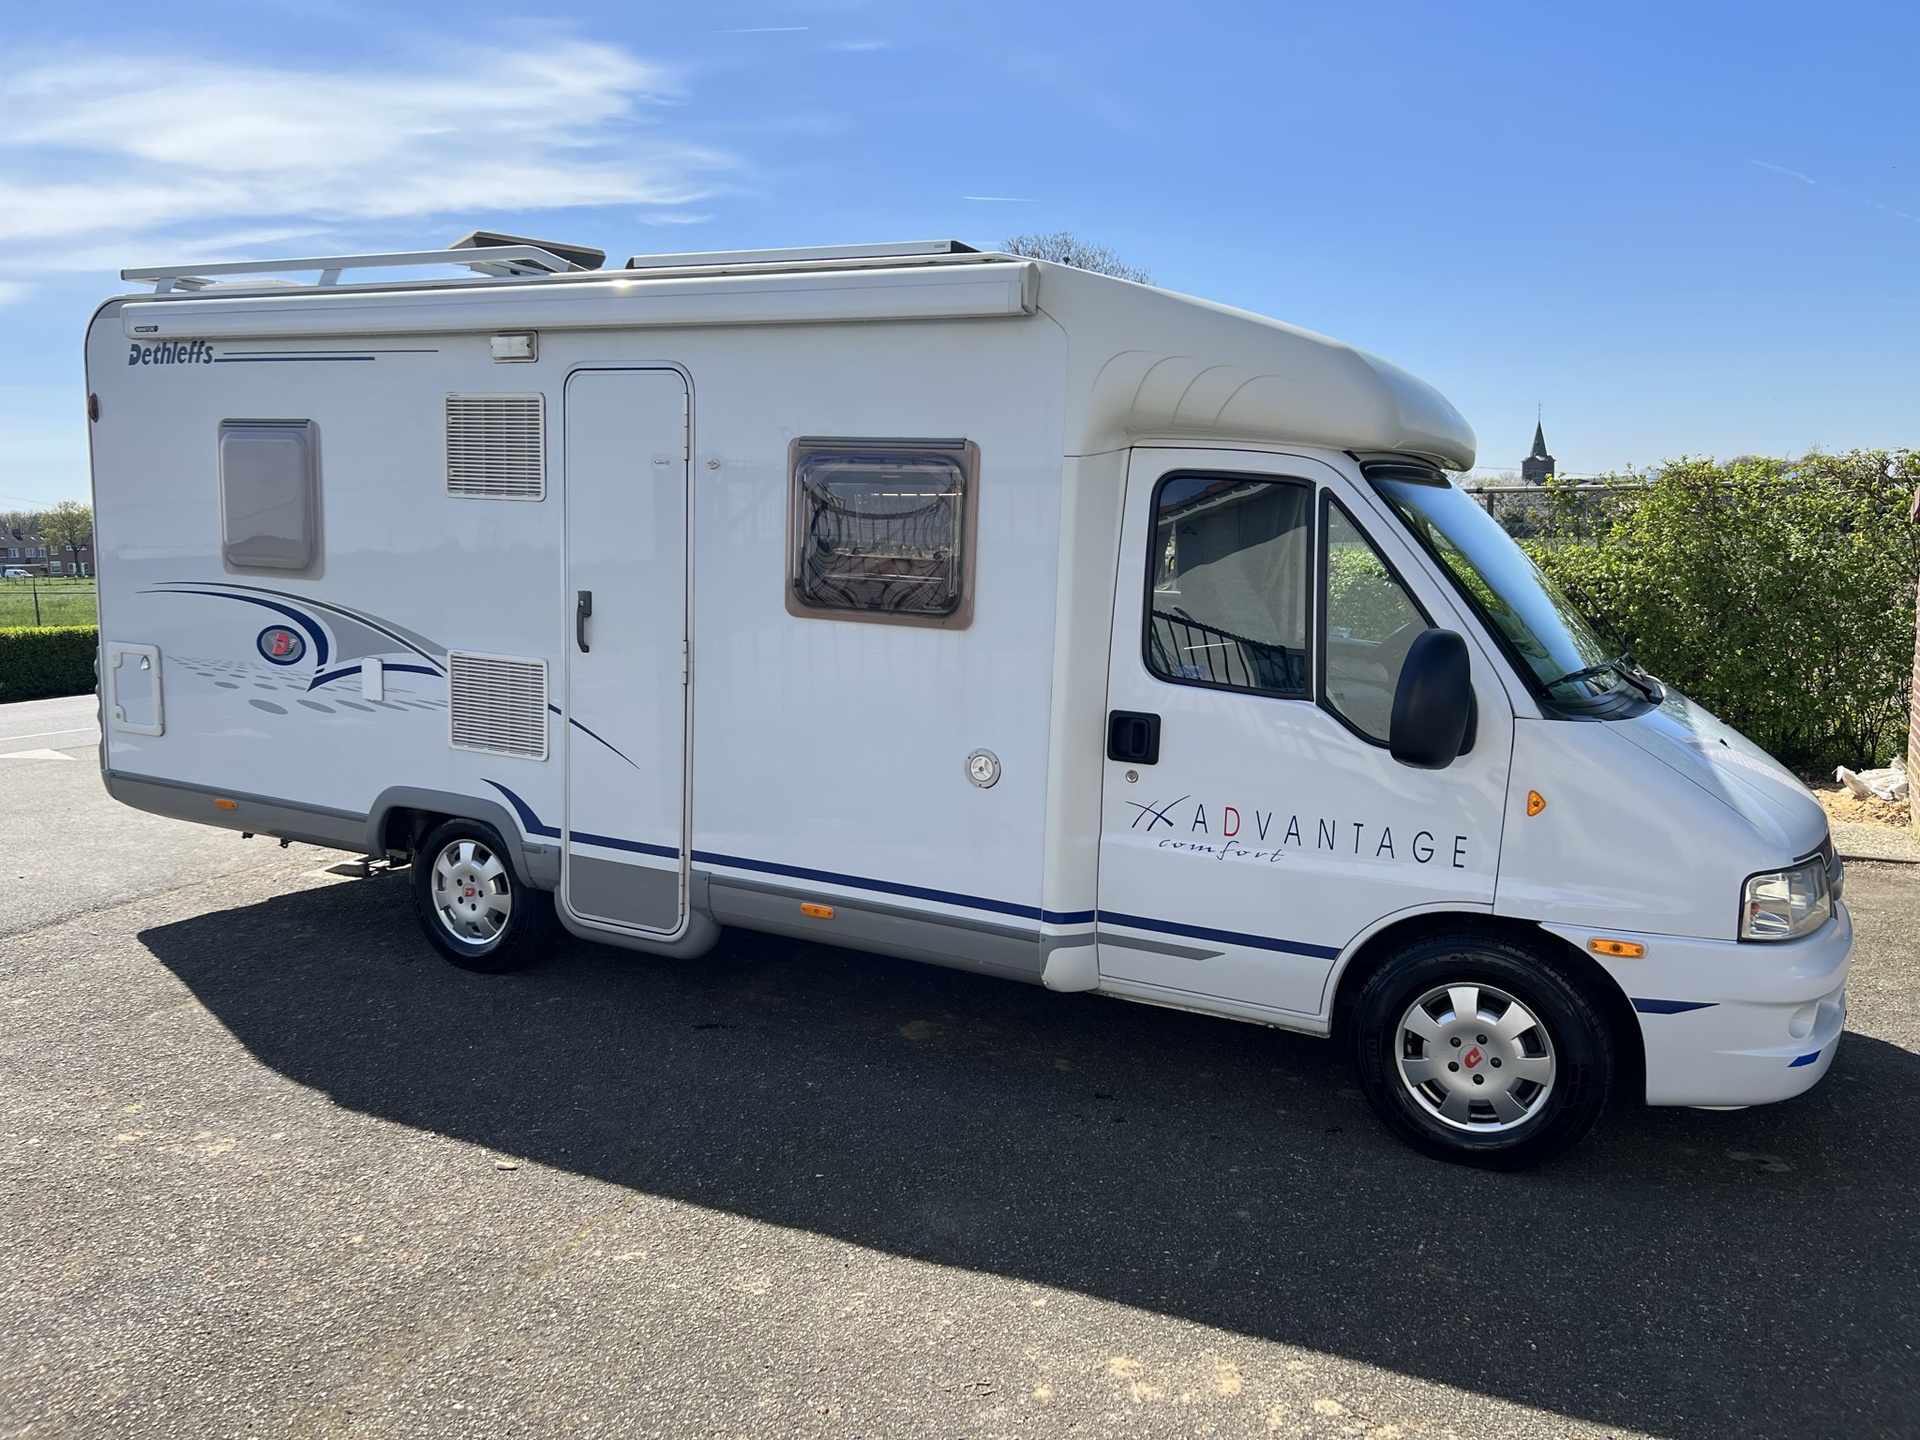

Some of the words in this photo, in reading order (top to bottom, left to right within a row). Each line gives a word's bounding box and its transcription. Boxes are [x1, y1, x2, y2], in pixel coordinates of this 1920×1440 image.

[128, 340, 214, 366] Dethleffs
[1191, 803, 1467, 869] ADVANTAGE
[1158, 838, 1286, 863] comfort
